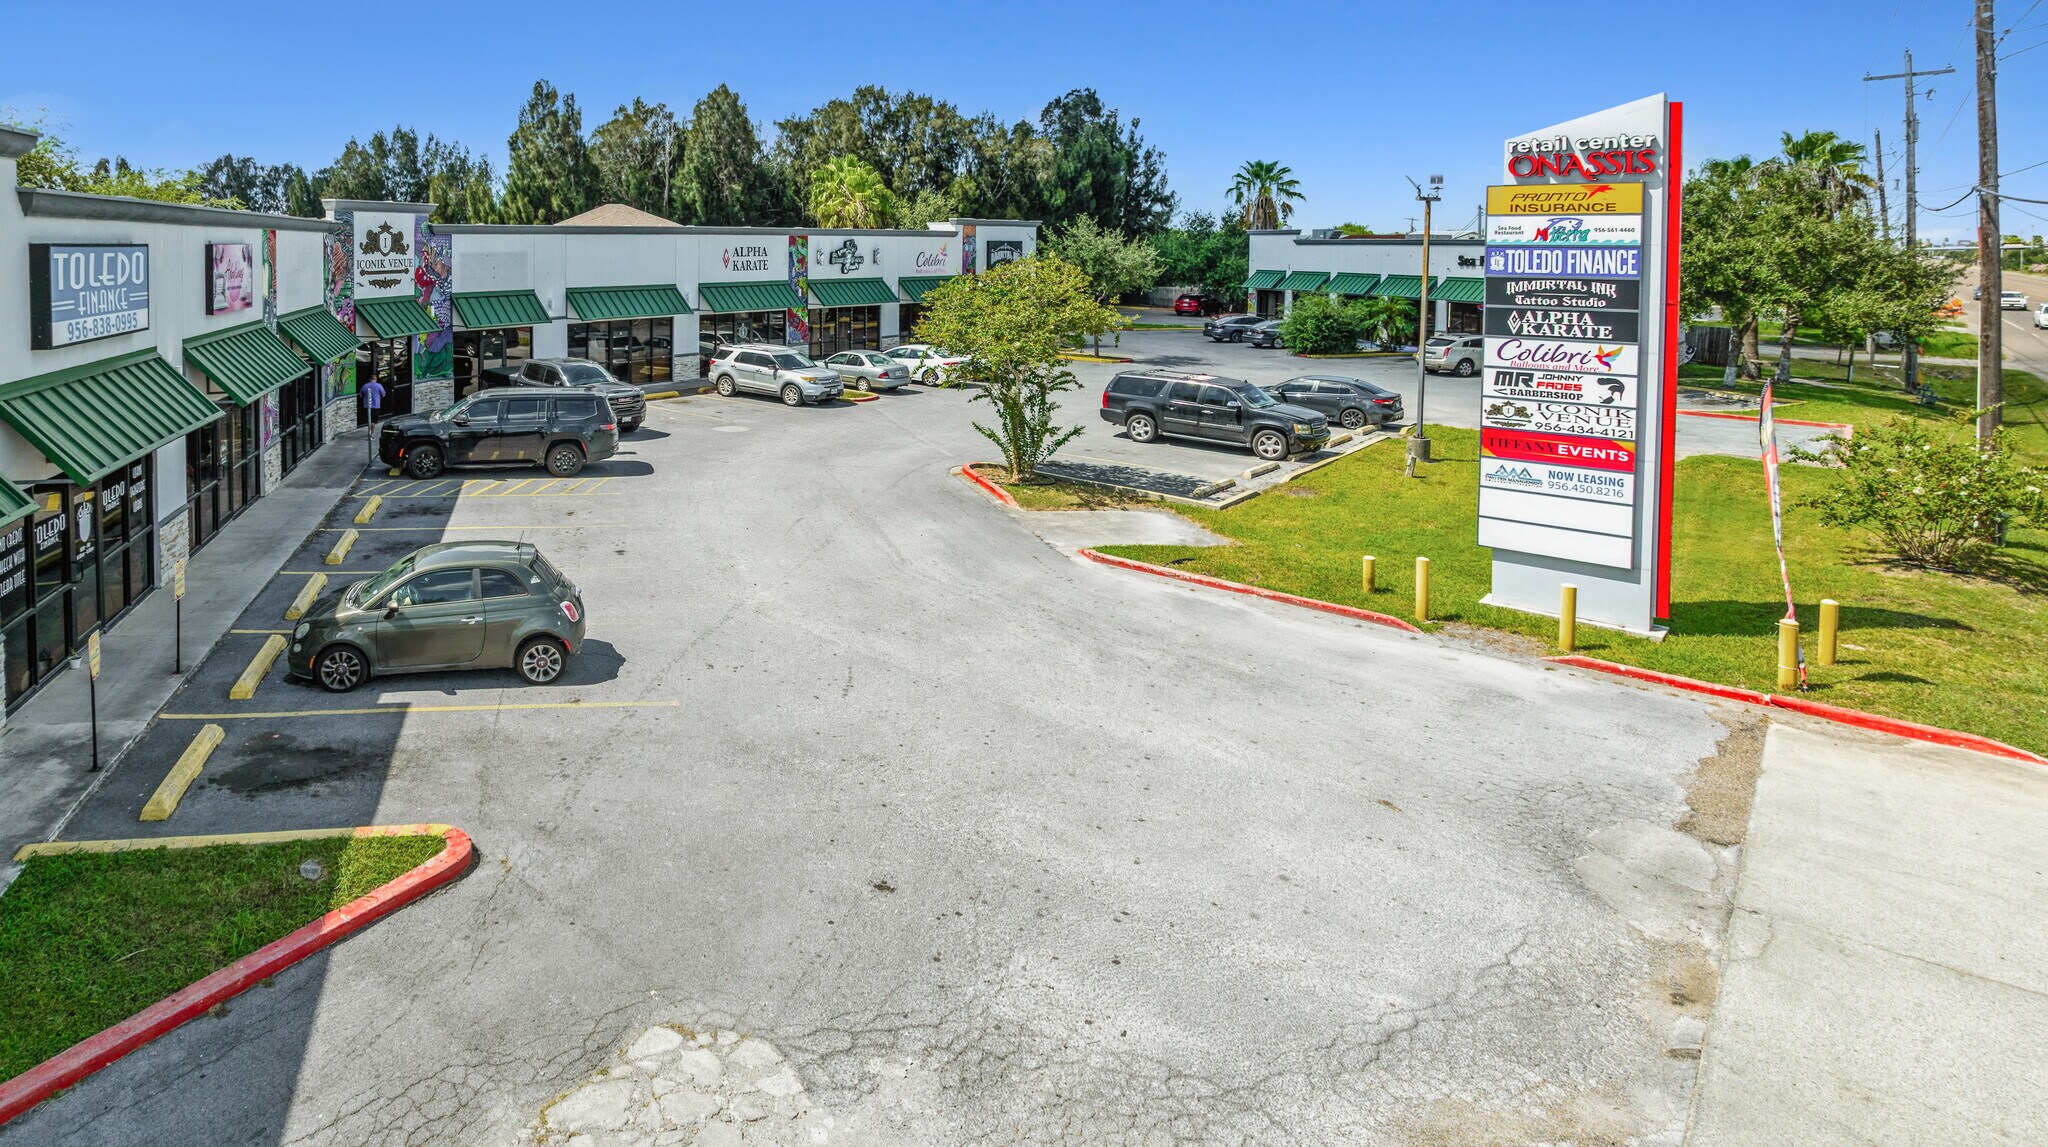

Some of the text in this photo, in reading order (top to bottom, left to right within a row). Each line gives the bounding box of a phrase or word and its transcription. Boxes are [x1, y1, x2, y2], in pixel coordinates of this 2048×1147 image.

[1508, 133, 1655, 153] retail center
[1508, 149, 1655, 181] ONASSIS
[1510, 192, 1588, 202] PRONTO
[1510, 203, 1617, 213] INSURANCE
[732, 246, 768, 257] ALPHA
[916, 251, 946, 268] Colibri
[1458, 255, 1476, 266] Sea
[53, 251, 145, 290] TOLEDO
[356, 258, 414, 270] ICONIK VENUE
[732, 260, 769, 271] KARATE
[1505, 249, 1638, 275] TOLEDO FINANCE
[1506, 280, 1617, 299] IMMORTAL INK
[78, 288, 128, 316] FINANCE
[1515, 295, 1607, 308] Tattoo Studio
[67, 312, 138, 341] 956-838-0995
[1521, 310, 1594, 326] ALPHA
[1521, 323, 1613, 339] KARATE
[1497, 338, 1592, 365] Colibri
[1510, 360, 1550, 370] Balloons
[1552, 363, 1571, 371] and
[1494, 370, 1584, 389] MR JOHNNY
[1536, 382, 1583, 392] FADES
[1509, 388, 1584, 401] BARBERSHOP
[1536, 402, 1634, 420] ICONIK
[1537, 411, 1632, 429] VENUE
[1535, 421, 1634, 439] 956-434-4121
[1486, 436, 1629, 462] TIFFANY EVENTS
[1548, 470, 1624, 488] NOW LEASING
[1548, 480, 1624, 498] 956.450.8216
